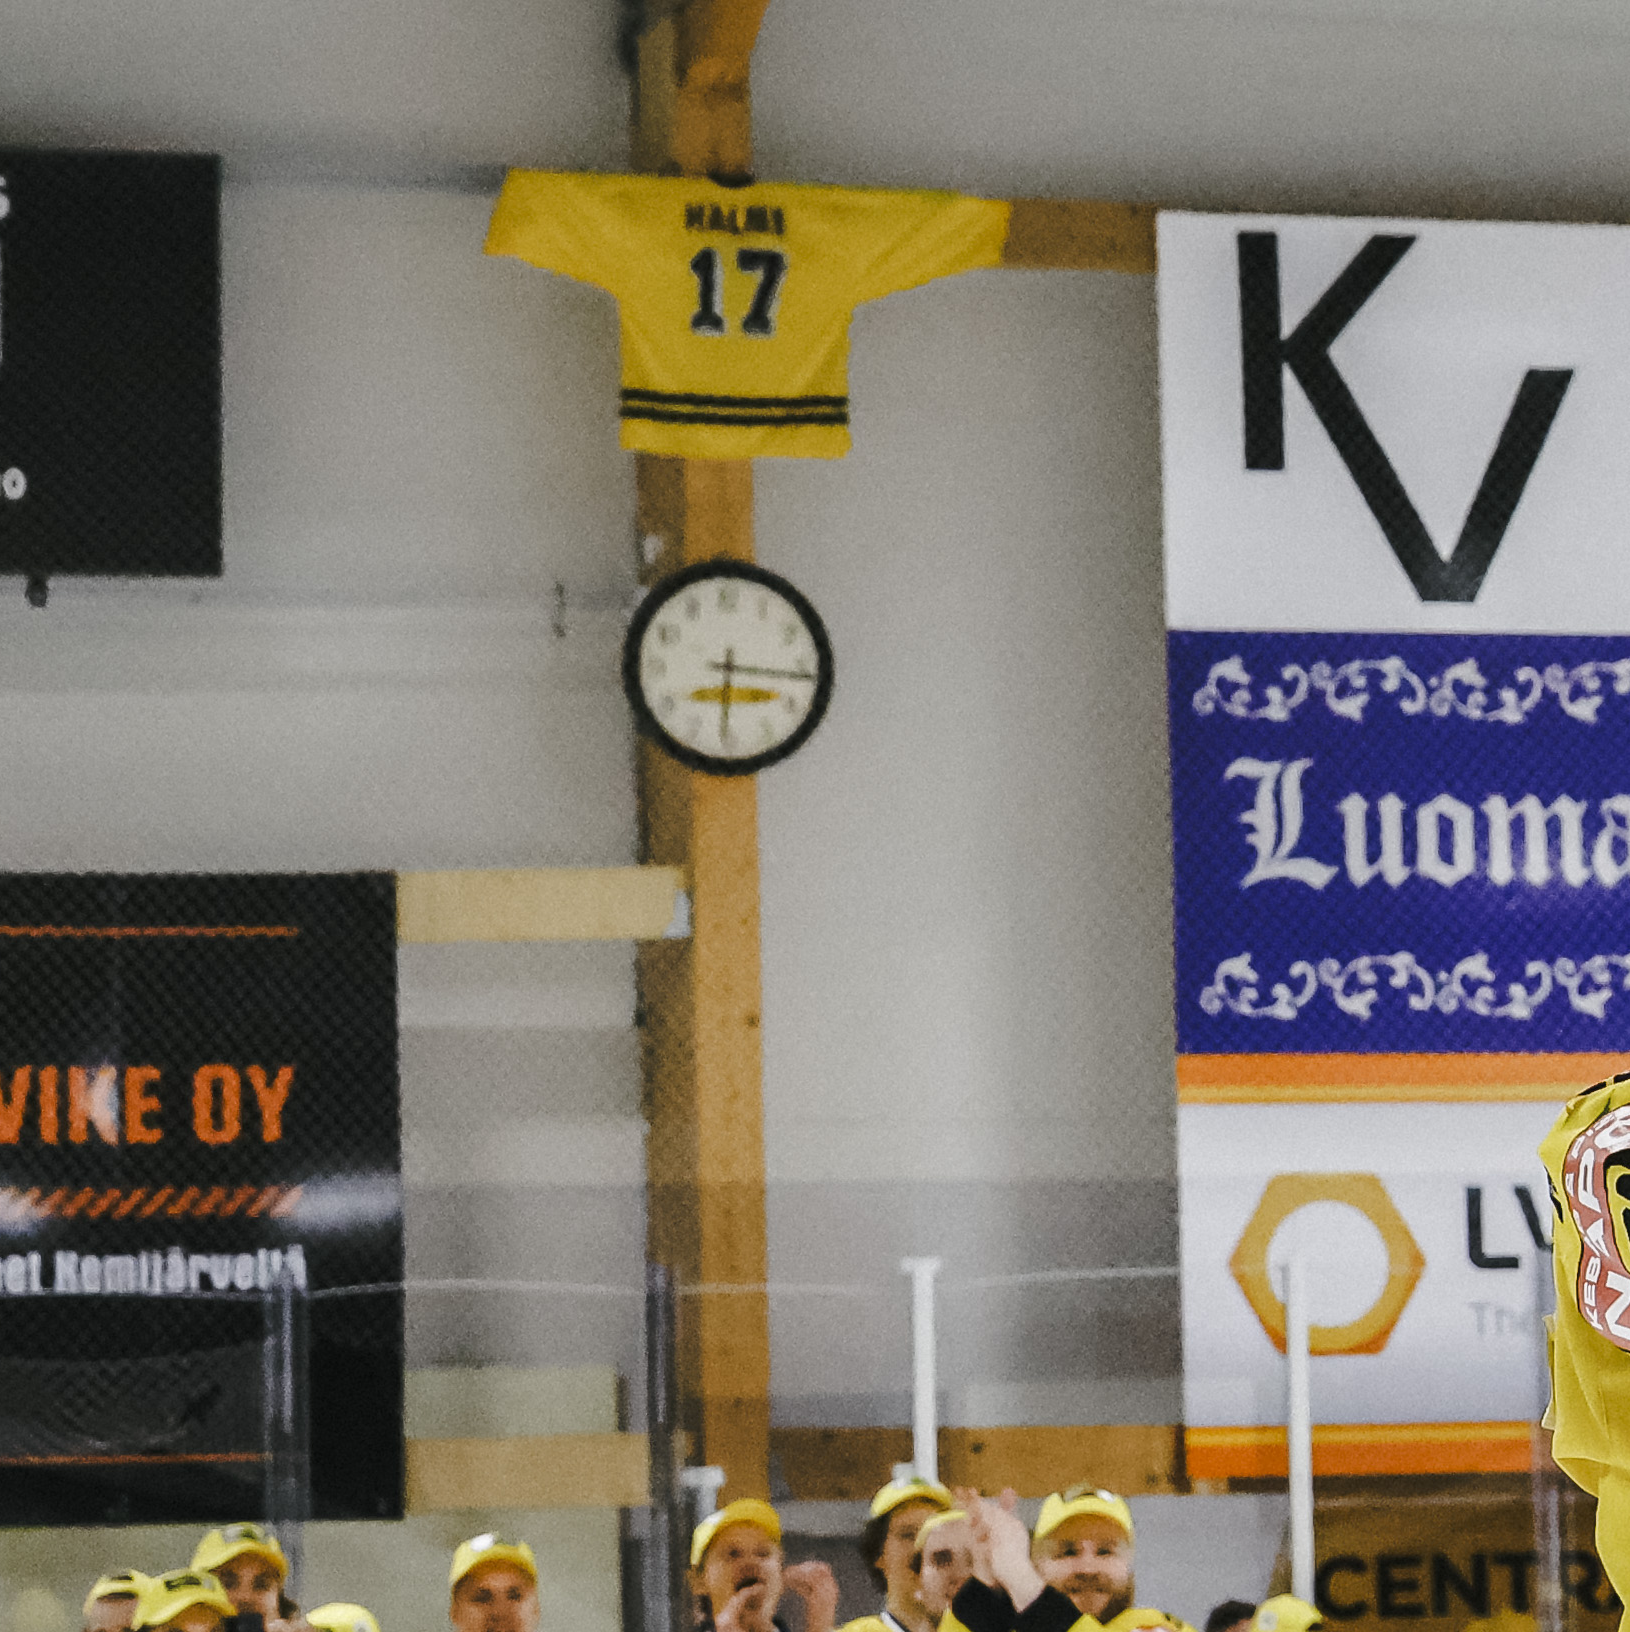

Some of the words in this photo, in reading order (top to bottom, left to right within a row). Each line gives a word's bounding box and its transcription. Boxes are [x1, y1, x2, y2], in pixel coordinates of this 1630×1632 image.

[689, 246, 789, 338] 17
[191, 1063, 296, 1146] OY
[1315, 1552, 1621, 1620] CENTR
